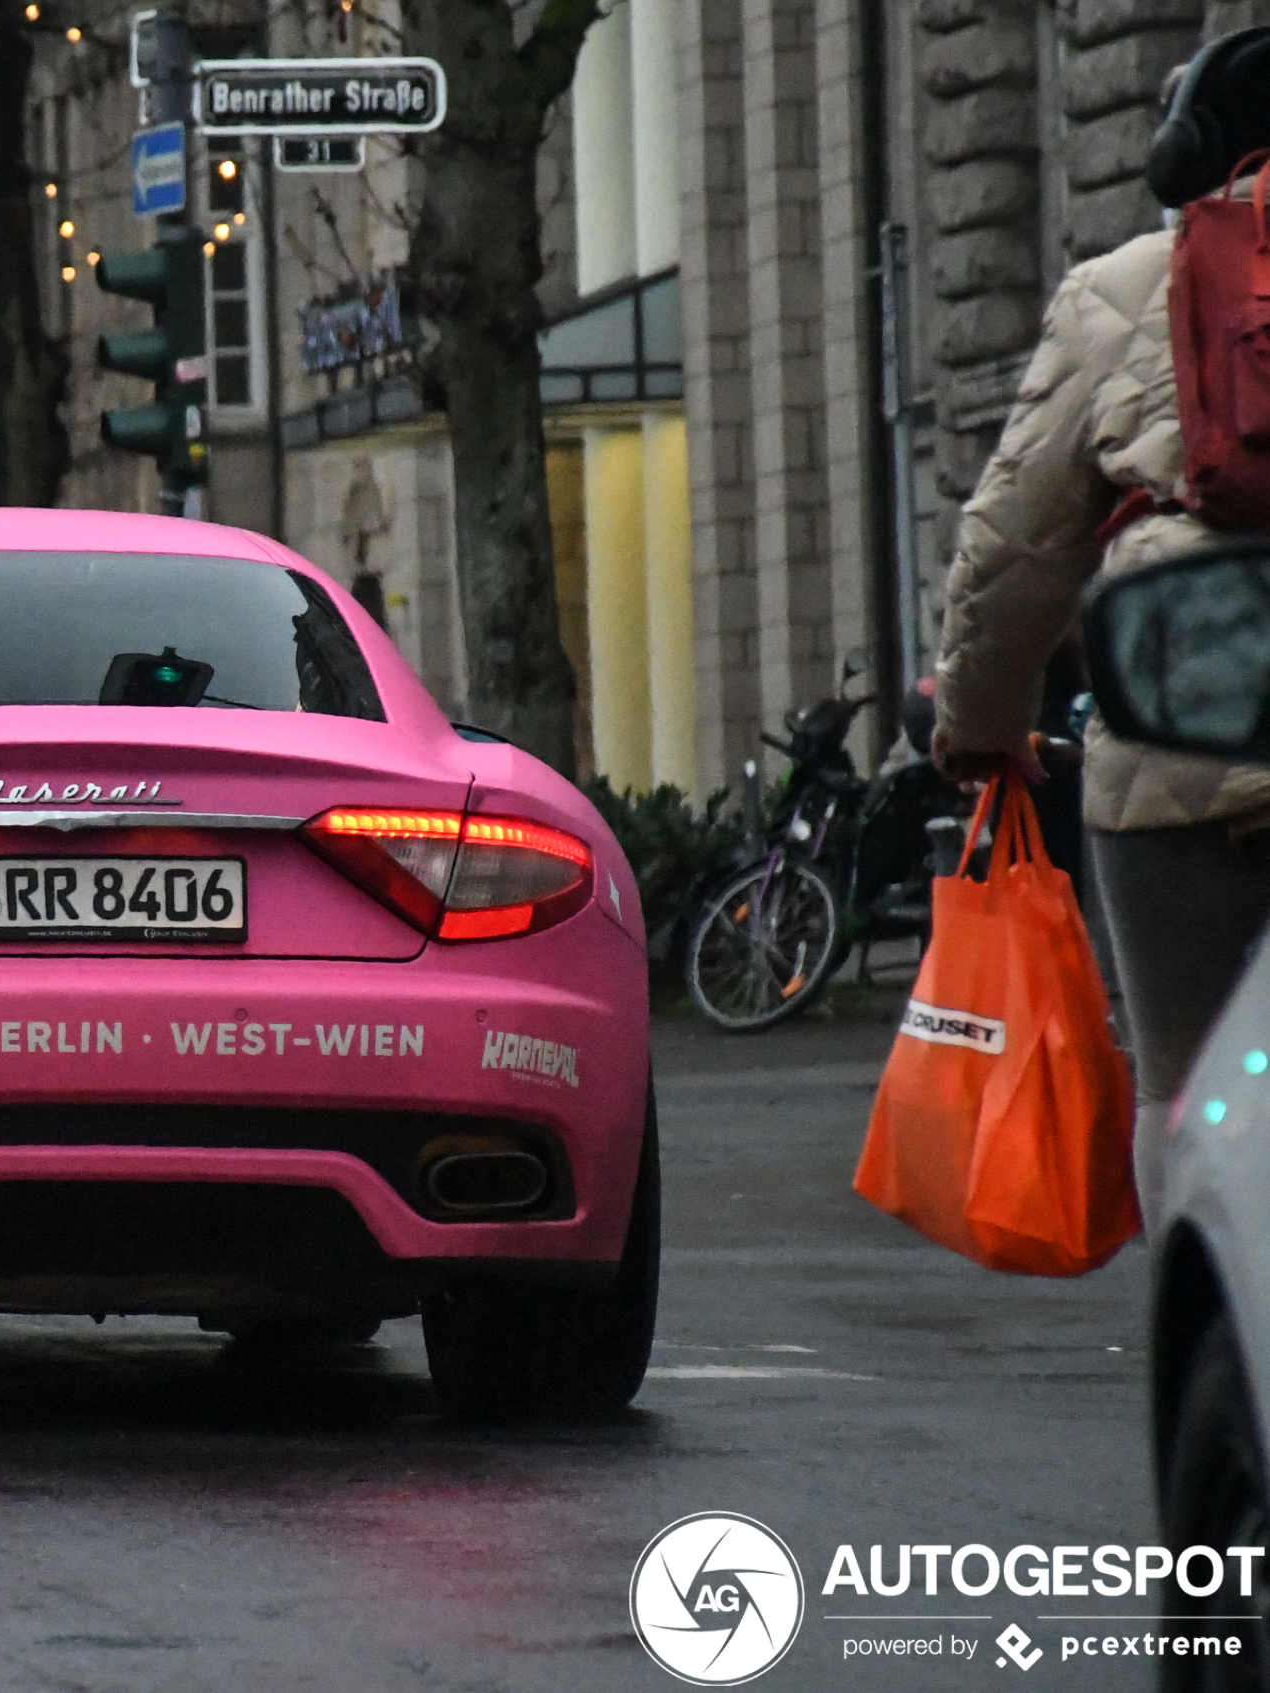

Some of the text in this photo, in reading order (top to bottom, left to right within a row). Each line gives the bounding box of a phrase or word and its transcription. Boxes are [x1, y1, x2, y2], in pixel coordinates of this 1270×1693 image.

[212, 79, 426, 116] Benrather Straße
[6, 866, 80, 922] RR
[92, 866, 235, 922] 8406
[170, 1022, 424, 1057] WEST-WIEN
[481, 1030, 580, 1088] KARNEVAL
